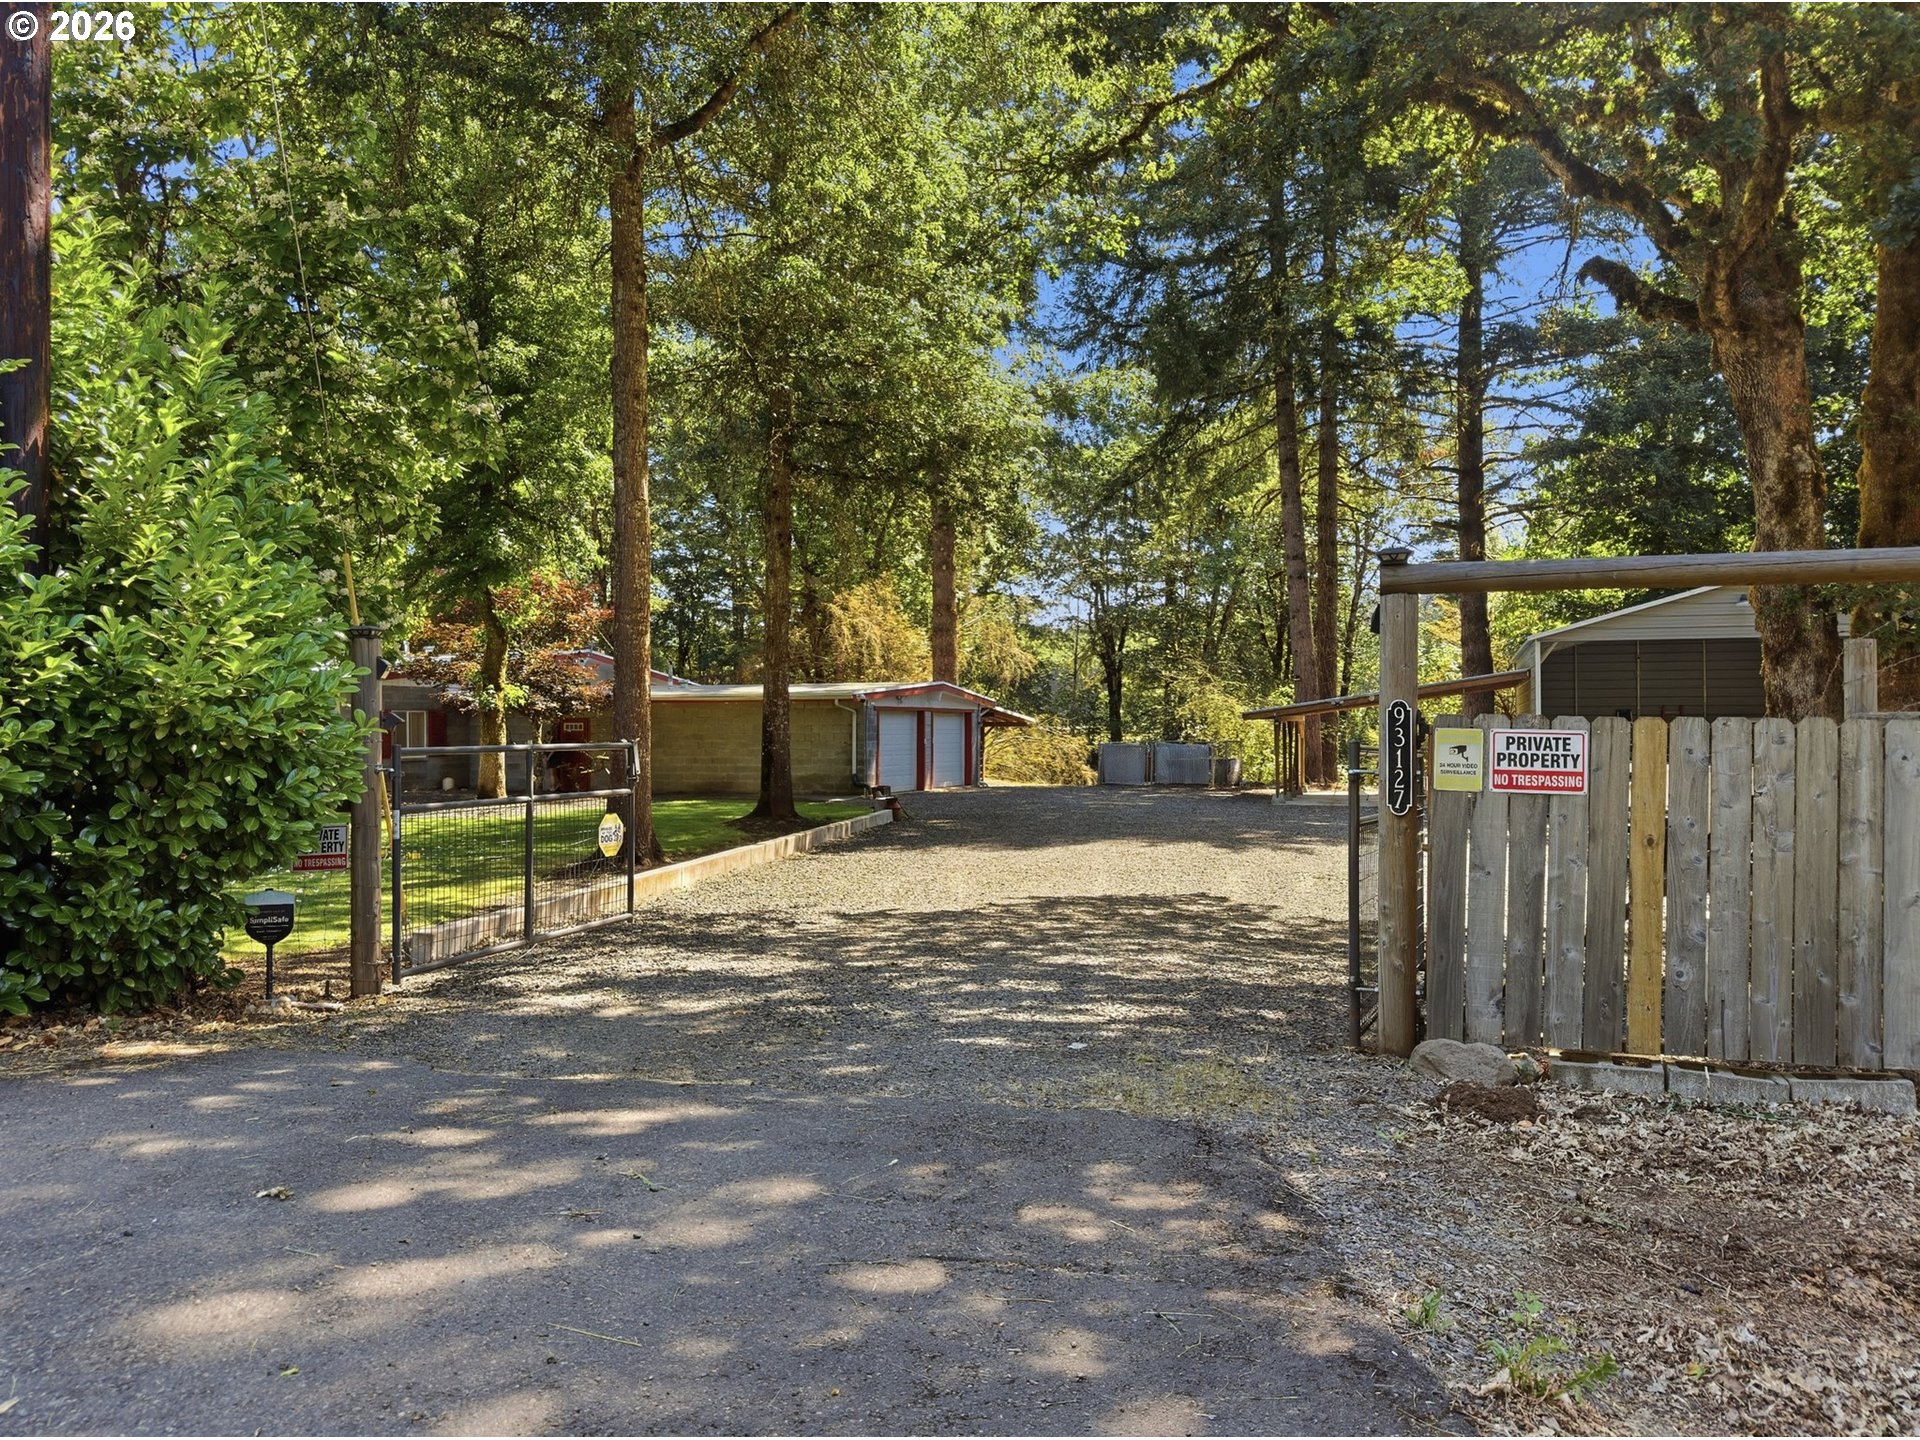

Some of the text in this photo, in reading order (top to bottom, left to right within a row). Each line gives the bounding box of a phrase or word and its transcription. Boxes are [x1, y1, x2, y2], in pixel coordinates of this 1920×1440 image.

[1505, 735, 1572, 752] PRIVATE
[1393, 706, 1406, 809] 93127
[1496, 752, 1581, 769] PROPERTY
[1494, 773, 1583, 788] NO TRESPASSING
[304, 857, 346, 867] TRESPASSING
[249, 916, 290, 925] SimpliSafe
